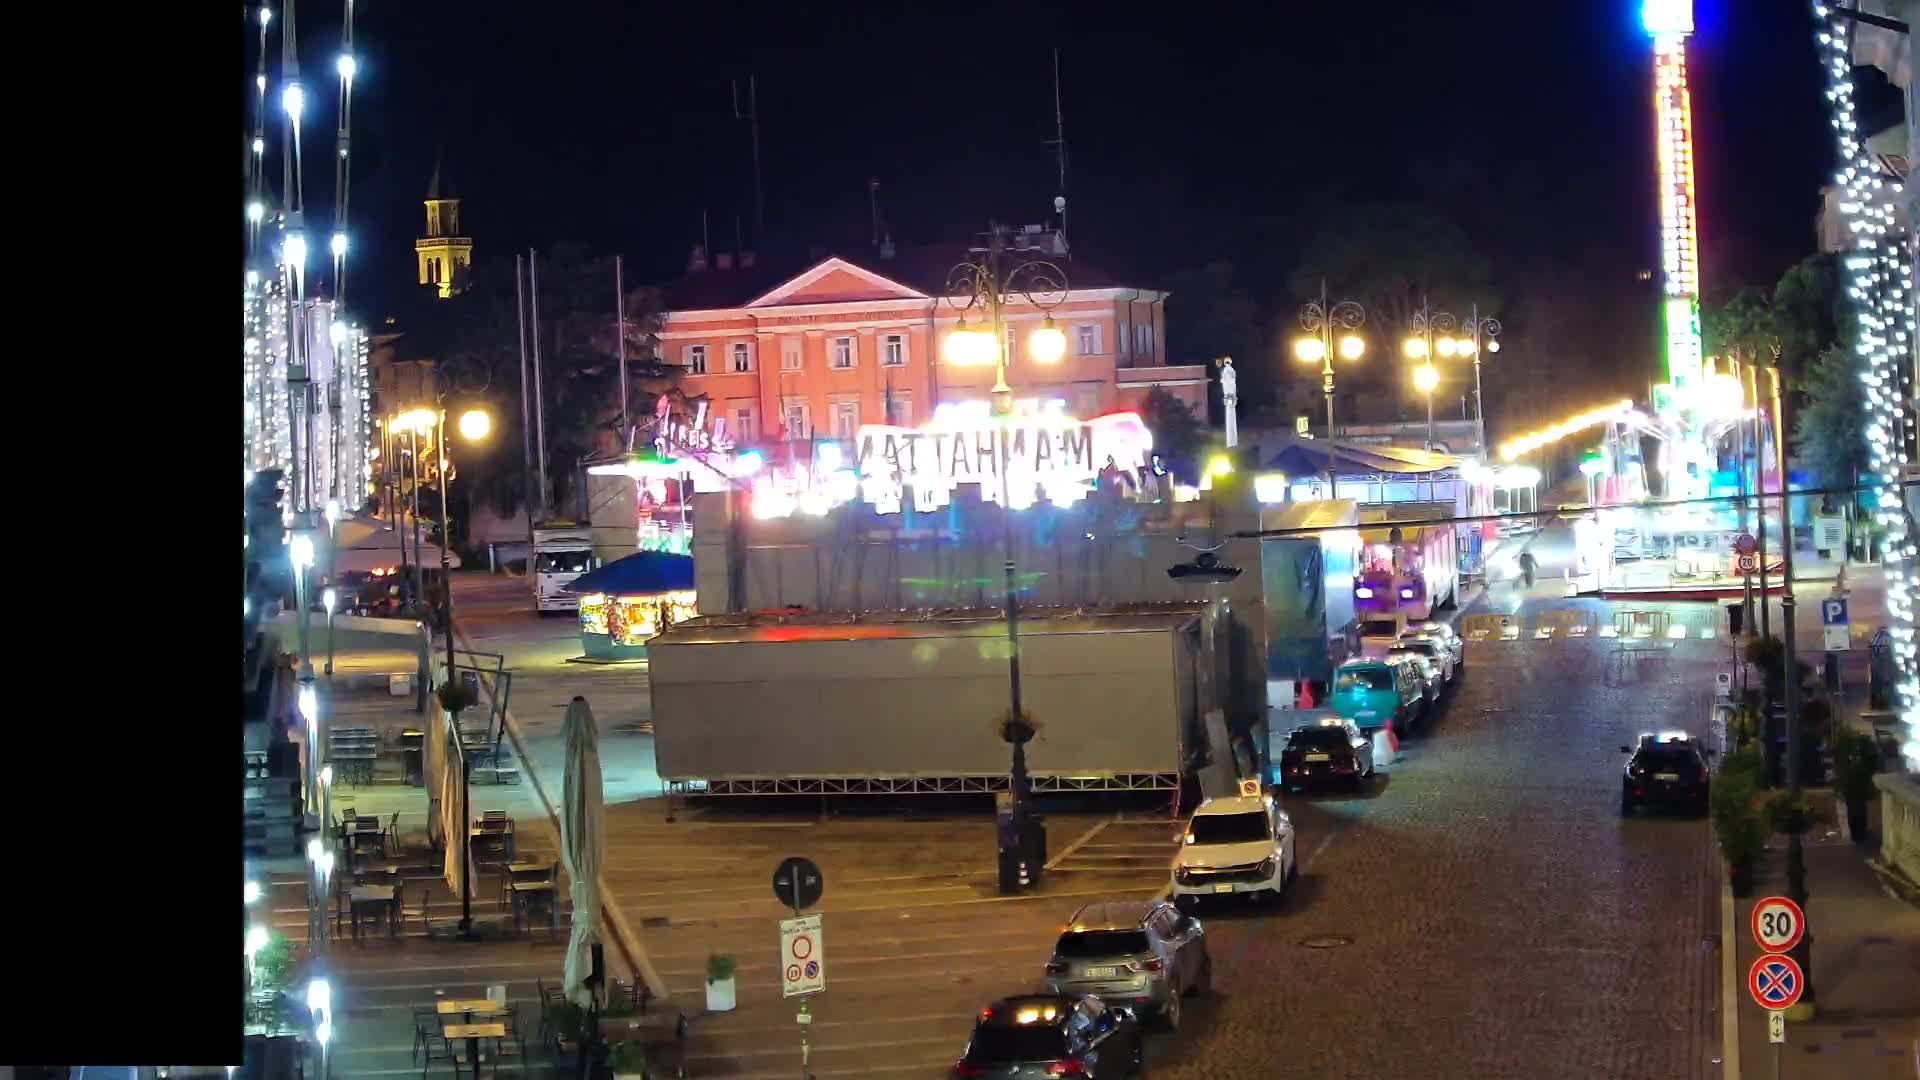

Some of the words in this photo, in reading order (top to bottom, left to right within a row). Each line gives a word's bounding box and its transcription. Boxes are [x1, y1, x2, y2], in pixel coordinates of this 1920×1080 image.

[1742, 558, 1753, 567] 20
[1826, 602, 1842, 623] P
[1763, 912, 1791, 937] 30
